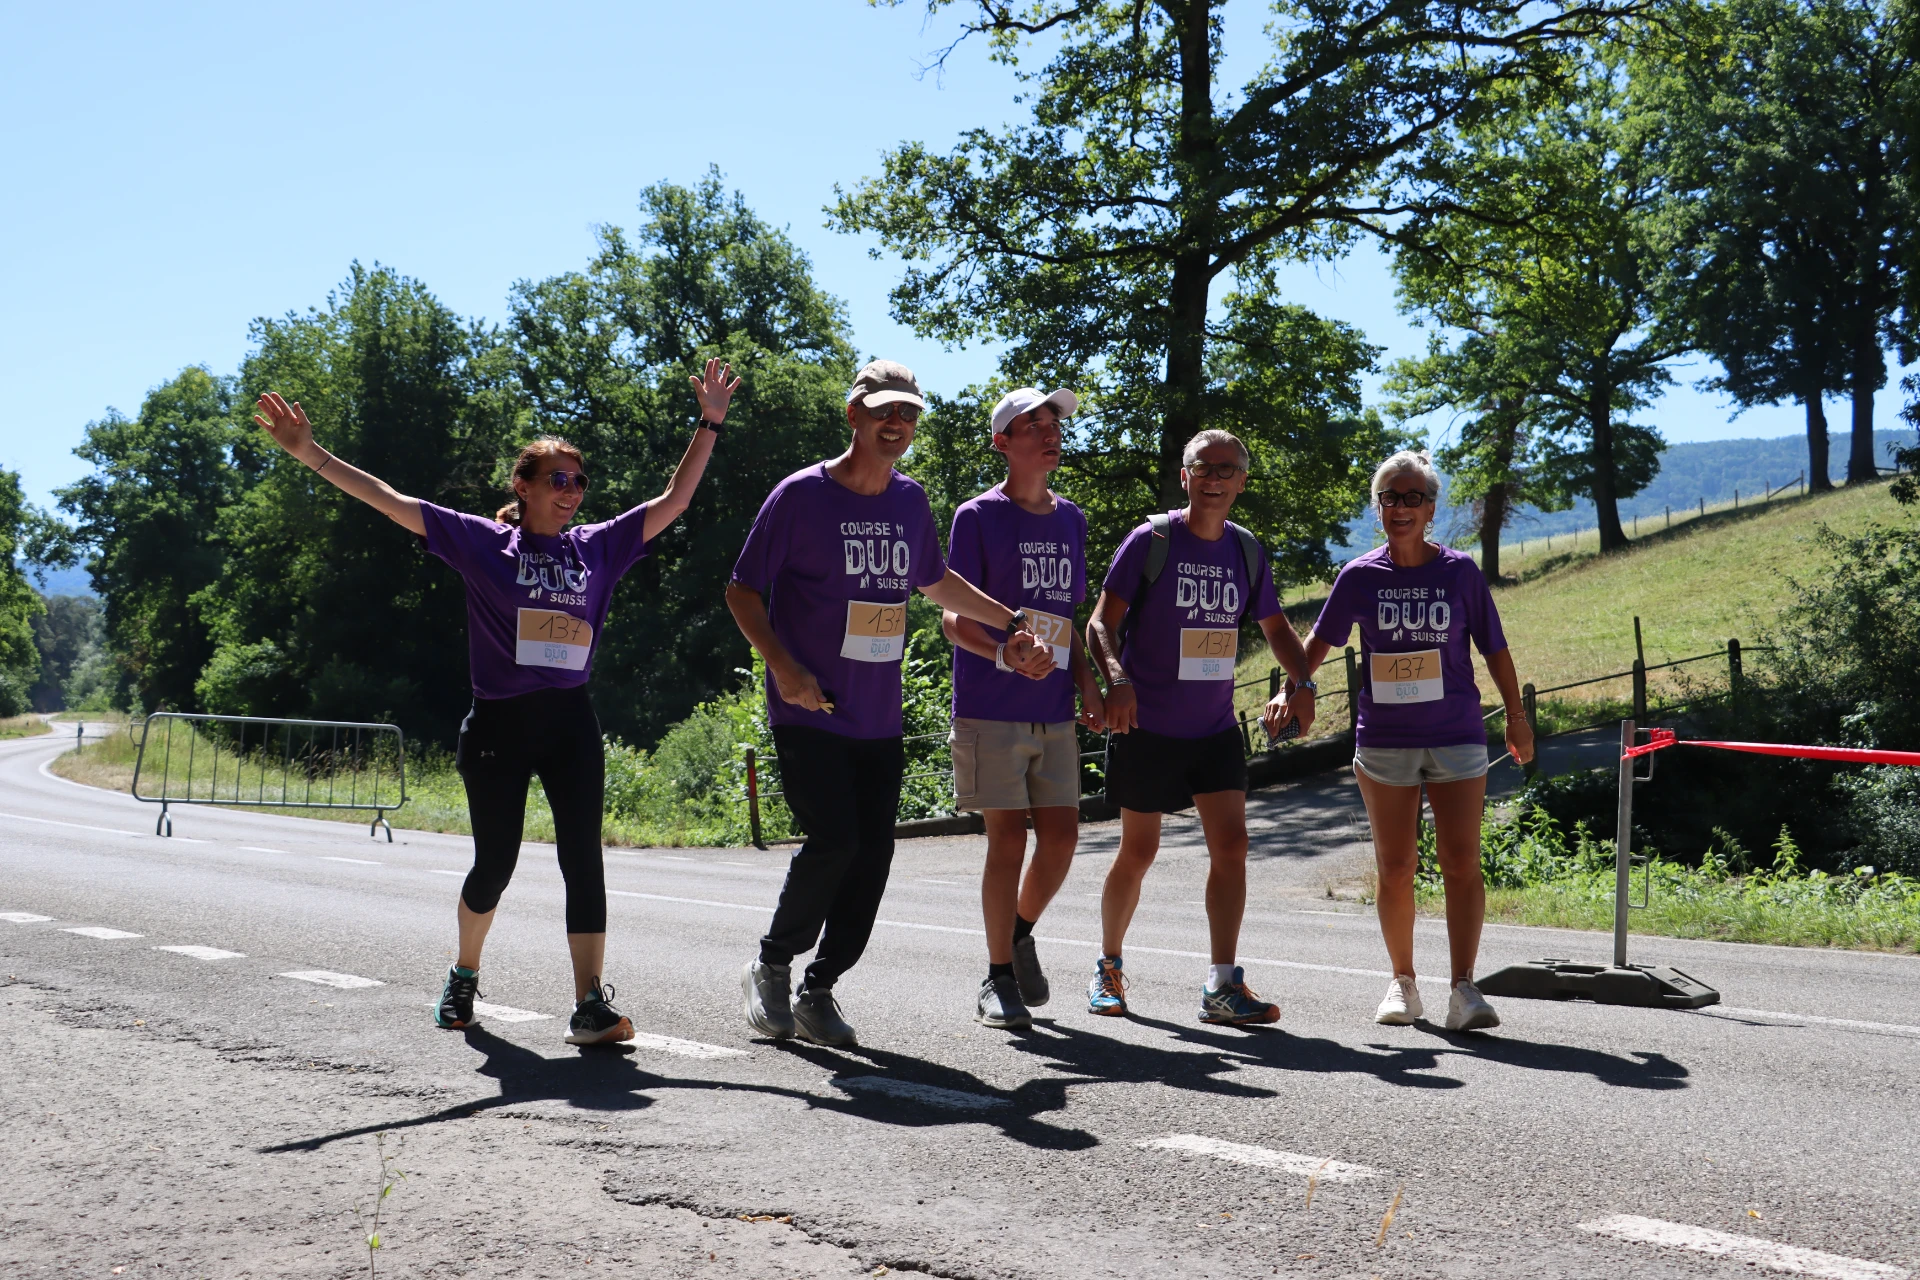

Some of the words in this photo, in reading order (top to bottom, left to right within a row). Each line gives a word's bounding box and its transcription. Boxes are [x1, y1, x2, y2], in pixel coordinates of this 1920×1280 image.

[840, 522, 891, 536] COURSE
[1019, 542, 1057, 554] COURSE
[844, 540, 909, 576] DUO
[516, 559, 588, 593] DUO
[1022, 557, 1072, 590] DUO
[1177, 562, 1223, 578] COURSE
[877, 578, 909, 590] SUISSE
[550, 592, 587, 606] SUISSE
[1045, 590, 1072, 603] SUISSE
[1176, 577, 1239, 613] DUO
[1377, 587, 1429, 600] COURSE
[868, 607, 903, 634] 137
[1204, 612, 1237, 624] SUISSE
[1377, 601, 1451, 631] DUO
[539, 615, 582, 641] 137
[1032, 613, 1064, 642] 137
[1197, 631, 1232, 657] 137
[1411, 631, 1449, 643] SUISSE
[544, 648, 567, 660] DUO
[1202, 663, 1220, 673] DUO
[1388, 656, 1425, 680] 137
[1395, 686, 1419, 697] DUO
